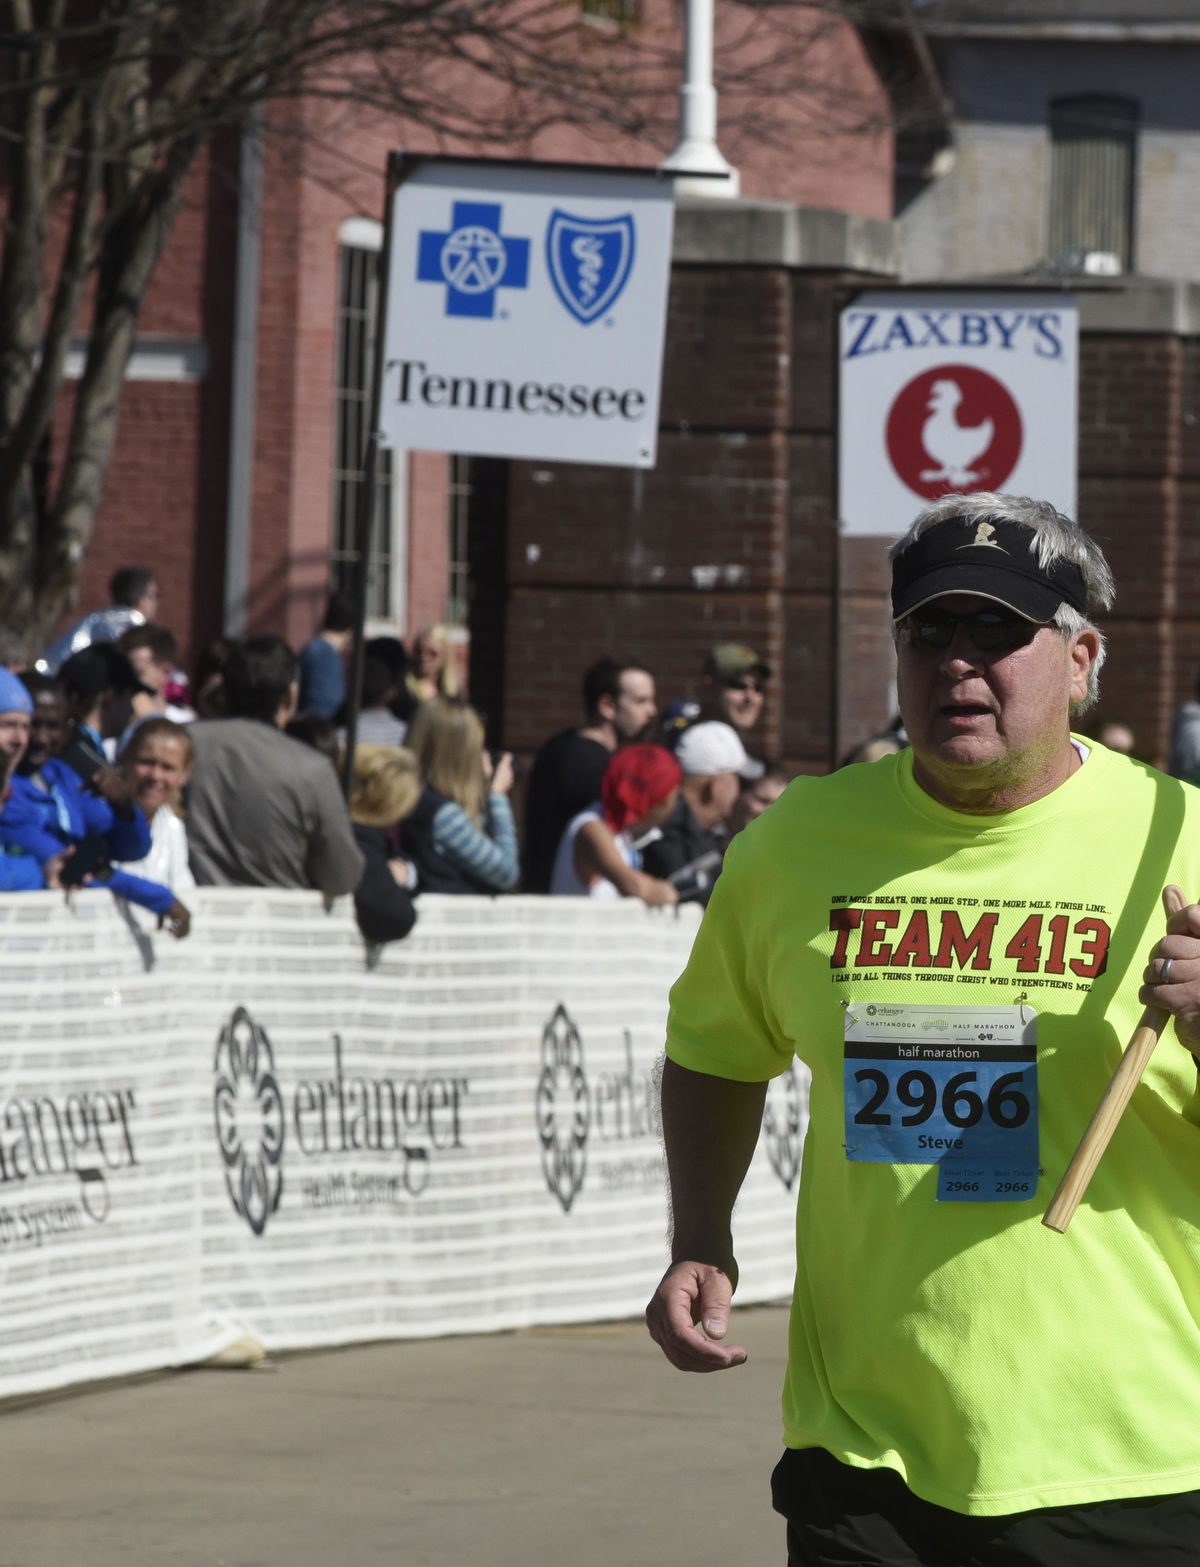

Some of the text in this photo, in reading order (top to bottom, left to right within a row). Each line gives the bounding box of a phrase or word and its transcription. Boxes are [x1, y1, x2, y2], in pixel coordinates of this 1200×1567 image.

[846, 312, 1063, 360] ZAXBY'S
[385, 359, 646, 421] Tennessee
[831, 895, 847, 904] ONE
[849, 895, 872, 904] MORE
[875, 896, 908, 905] BREATH,
[910, 896, 927, 904] ONE
[930, 897, 954, 905] MORE
[957, 898, 980, 907] STEP,
[983, 899, 1000, 907] ONE
[1002, 900, 1026, 908] MORE
[1029, 901, 1052, 909] MILE,
[1055, 901, 1083, 910] FINISH
[829, 908, 1111, 979] TEAM 413
[835, 973, 849, 982] CAN
[852, 973, 862, 981] DO
[863, 972, 879, 981] ALL
[882, 972, 911, 981] THINGS
[915, 973, 954, 982] THROUGH
[957, 975, 986, 984] CHRIST
[989, 977, 1008, 986] WHO
[1011, 978, 1073, 990] STRENGTHENS
[877, 1007, 904, 1016] erlanger
[898, 1045, 979, 1058] half marathon
[854, 1068, 1030, 1129] 2966
[294, 1034, 470, 1197] erlanger
[918, 1135, 963, 1149] Steve
[964, 1169, 984, 1177] Ticket
[945, 1181, 979, 1192] 2966
[995, 1182, 1029, 1193] 2966
